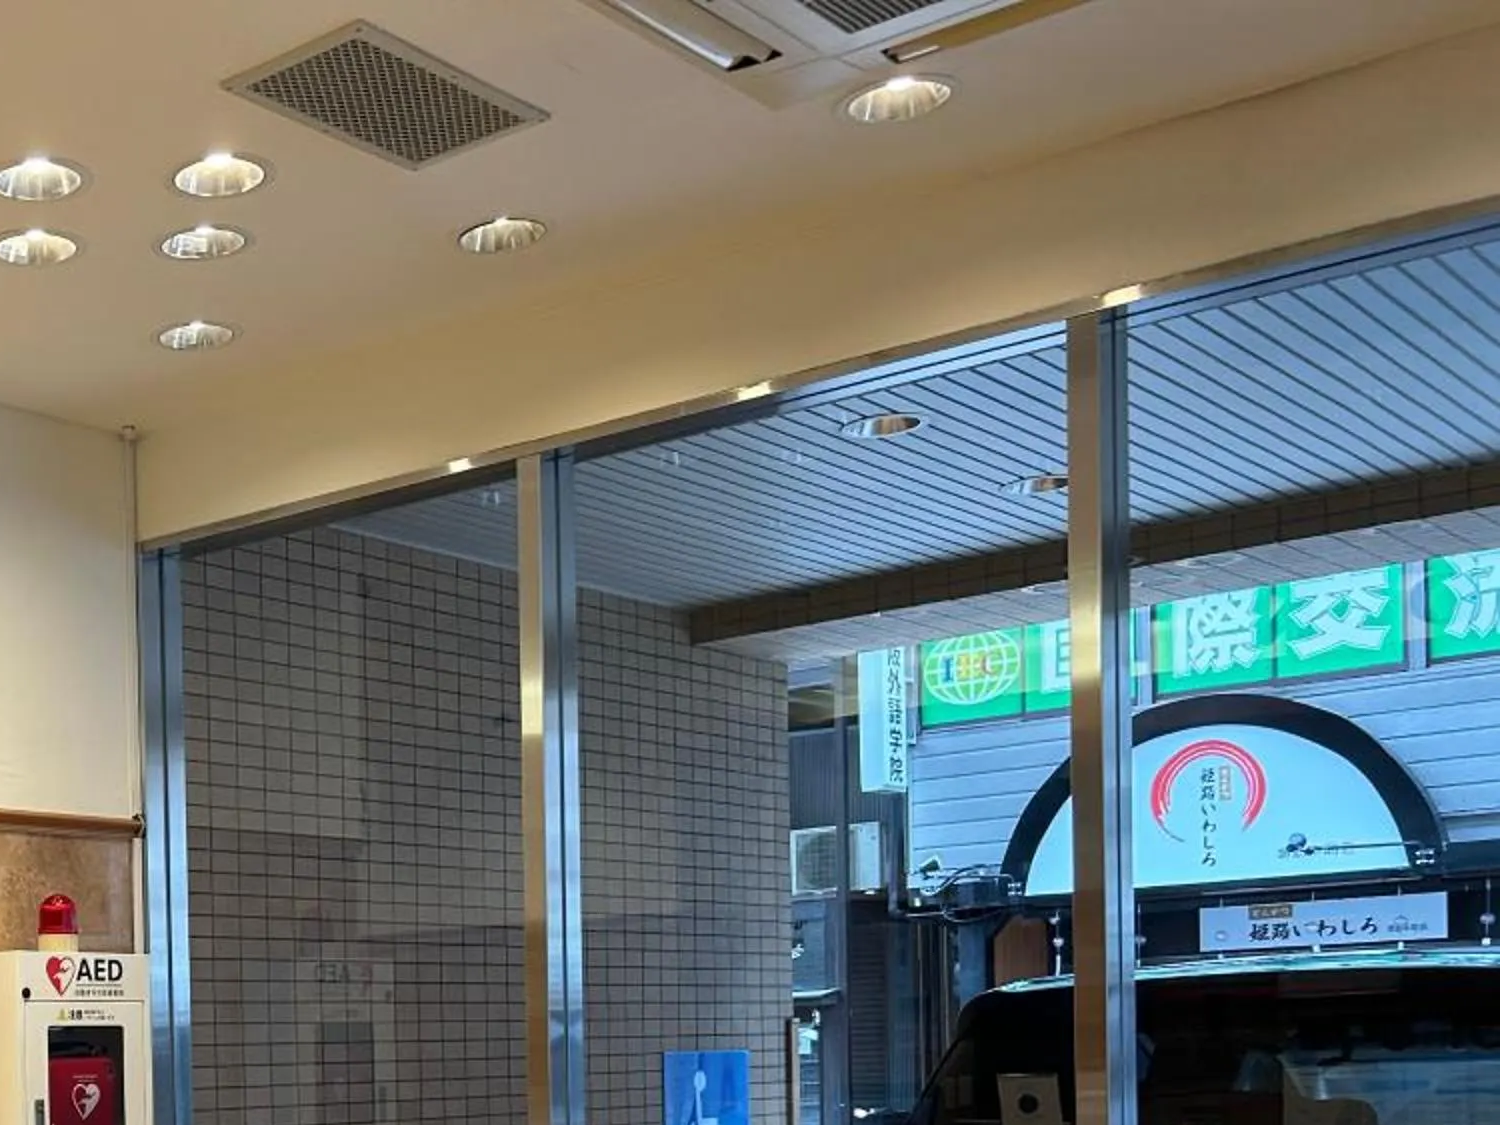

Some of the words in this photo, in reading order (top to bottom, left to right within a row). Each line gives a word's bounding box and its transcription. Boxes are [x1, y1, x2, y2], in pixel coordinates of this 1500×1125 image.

[1200, 767, 1217, 868] 姫路いわしろ
[76, 957, 123, 982] AED
